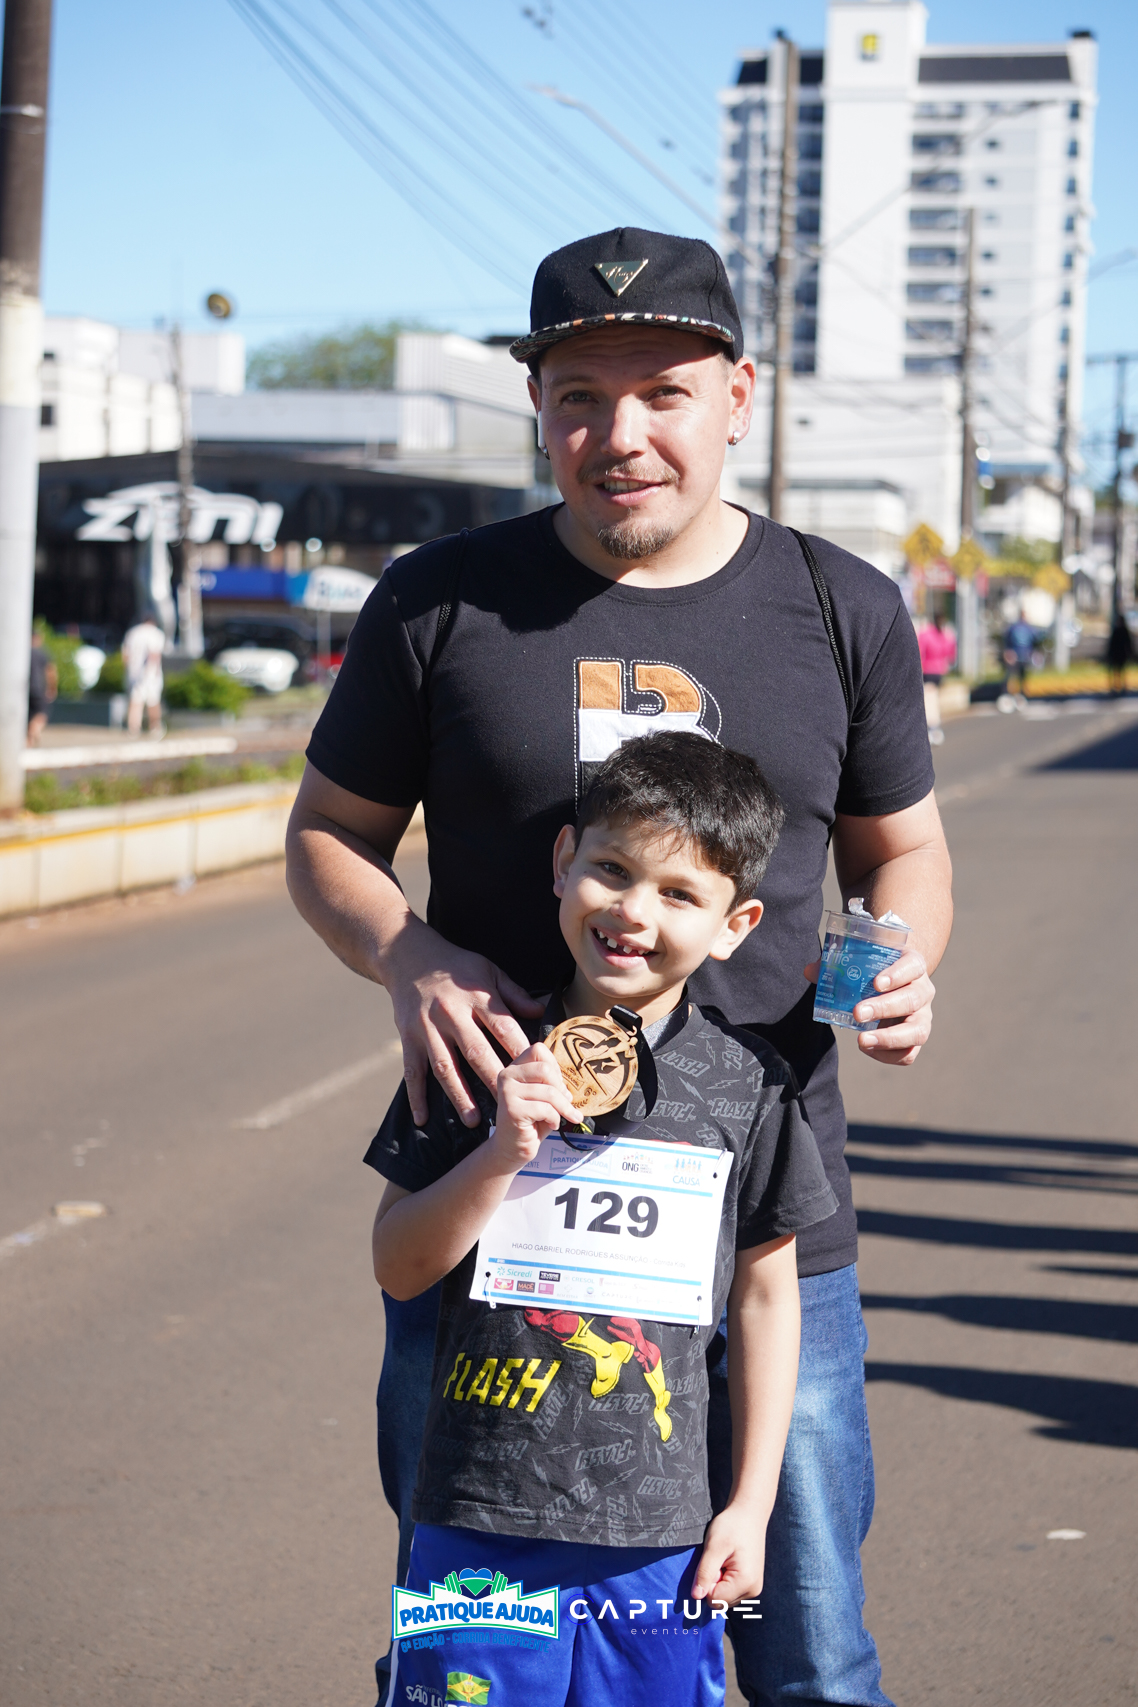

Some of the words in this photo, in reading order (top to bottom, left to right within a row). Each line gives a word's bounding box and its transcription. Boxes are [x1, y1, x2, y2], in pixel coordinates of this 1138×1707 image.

[622, 1161, 640, 1172] ONG
[673, 1175, 700, 1186] CAUSA
[554, 1187, 659, 1238] 129
[511, 1242, 533, 1250] HIAGO
[534, 1244, 563, 1253] GABRIEL
[565, 1247, 608, 1259] RODRIGUES
[507, 1268, 532, 1278] Sicredi
[571, 1276, 595, 1284] CRESOL
[443, 1352, 562, 1412] FLASH
[406, 1684, 428, 1706] SÃO
